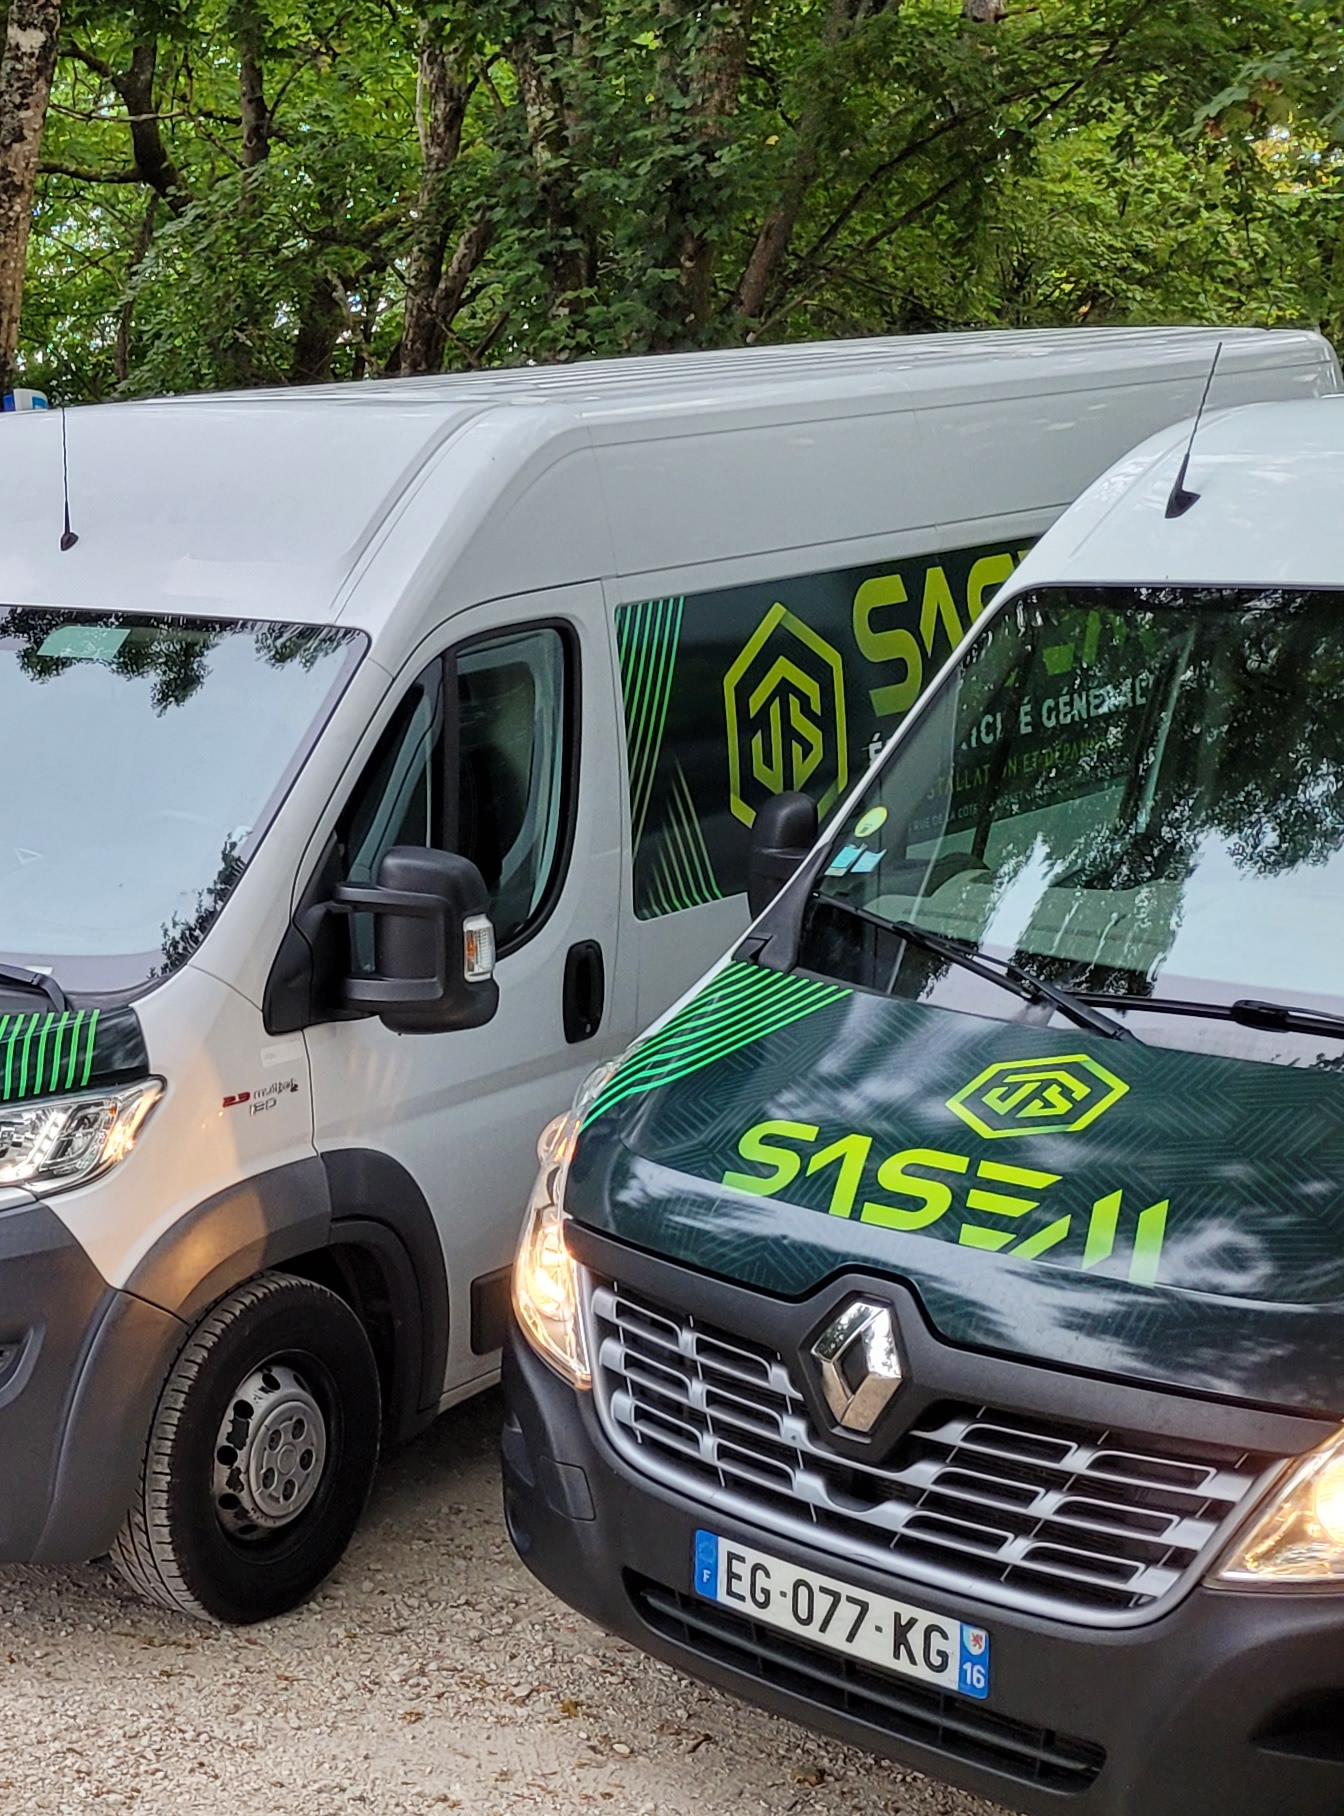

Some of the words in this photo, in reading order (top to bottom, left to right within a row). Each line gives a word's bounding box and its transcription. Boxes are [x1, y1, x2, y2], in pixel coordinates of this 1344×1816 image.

[1041, 667, 1155, 729] GÉNÉRAL
[721, 1119, 1170, 1288] SASEM
[702, 1568, 711, 1584] F
[725, 1550, 950, 1674] EG-077-KG
[962, 1661, 986, 1689] 16
